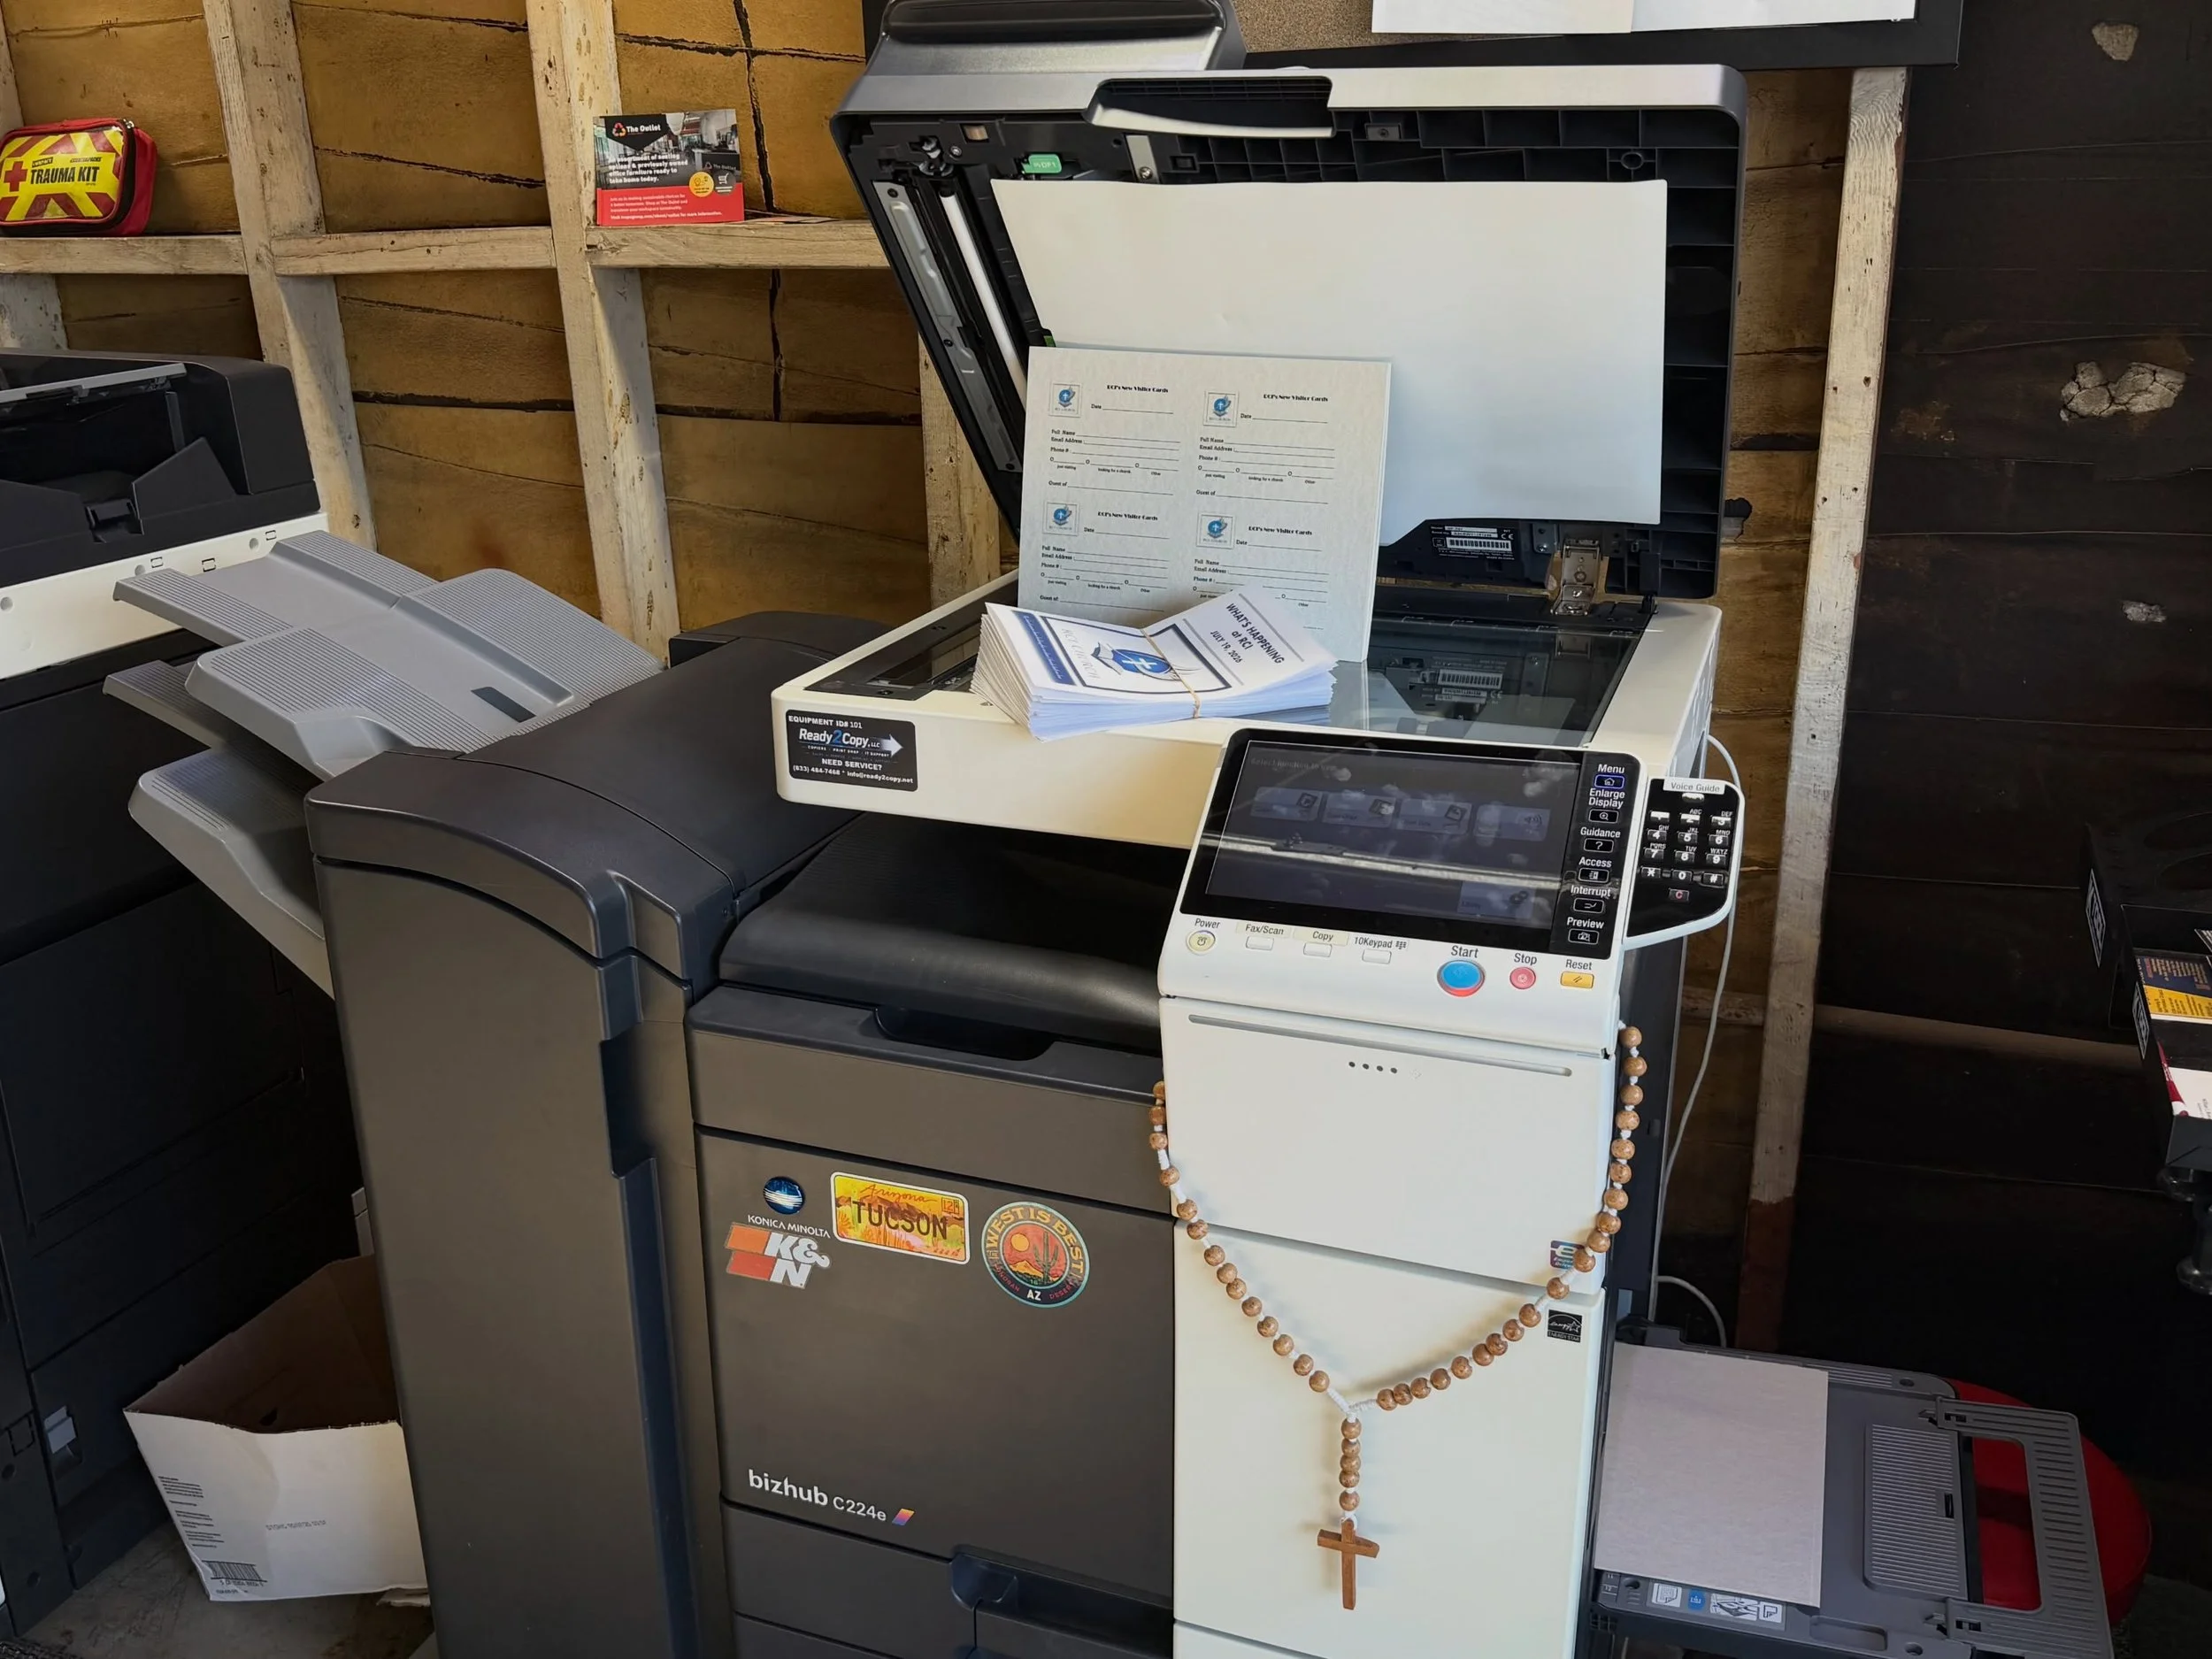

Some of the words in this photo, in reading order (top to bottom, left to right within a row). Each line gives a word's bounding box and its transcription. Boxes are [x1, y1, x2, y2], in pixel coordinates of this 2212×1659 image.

[638, 161, 668, 171] previously
[31, 167, 75, 184] TRAUMA
[78, 166, 100, 182] KIT
[1210, 630, 1225, 643] JULY
[1225, 603, 1252, 628] WHAT'S
[1246, 626, 1285, 664] HAPPENING
[1231, 630, 1242, 639] at
[1238, 636, 1254, 650] RCI
[788, 715, 834, 726] EQUIPMENT
[821, 757, 843, 766] NEED
[844, 760, 882, 771] SERVICE?
[1598, 764, 1625, 774] Menu
[1589, 787, 1625, 799] Enlarge
[1671, 782, 1694, 791] Voice
[1695, 783, 1721, 793] Guide
[1588, 796, 1624, 810] Display
[1580, 826, 1621, 839] Guidance
[1652, 831, 1661, 840] 4
[1715, 836, 1723, 845] 6
[1651, 849, 1658, 858] 7
[1712, 855, 1721, 864] 9
[1578, 856, 1612, 868] Access
[1571, 885, 1611, 898] Interrupt
[1194, 918, 1221, 929] Power
[1245, 924, 1285, 935] Fax/Scan
[1566, 917, 1605, 930] Preview
[1312, 931, 1334, 942] Copy
[1354, 936, 1393, 949] 10Keypad
[1450, 945, 1479, 958] Start
[1514, 952, 1538, 966] Stop
[1565, 958, 1593, 971] Reset
[860, 1184, 937, 1202] Arizona
[747, 1214, 787, 1230] KONICA
[787, 1223, 831, 1239] MINOLTA
[852, 1201, 949, 1240] TUCSON
[986, 1207, 1025, 1248] WEST
[1029, 1207, 1051, 1224] IS
[1052, 1219, 1084, 1274] BEST
[994, 1263, 1020, 1293] SONORAN
[1026, 1289, 1041, 1301] AZ
[1048, 1279, 1076, 1300] DESERT
[748, 1468, 829, 1507] bizhub
[833, 1495, 887, 1522] C224e
